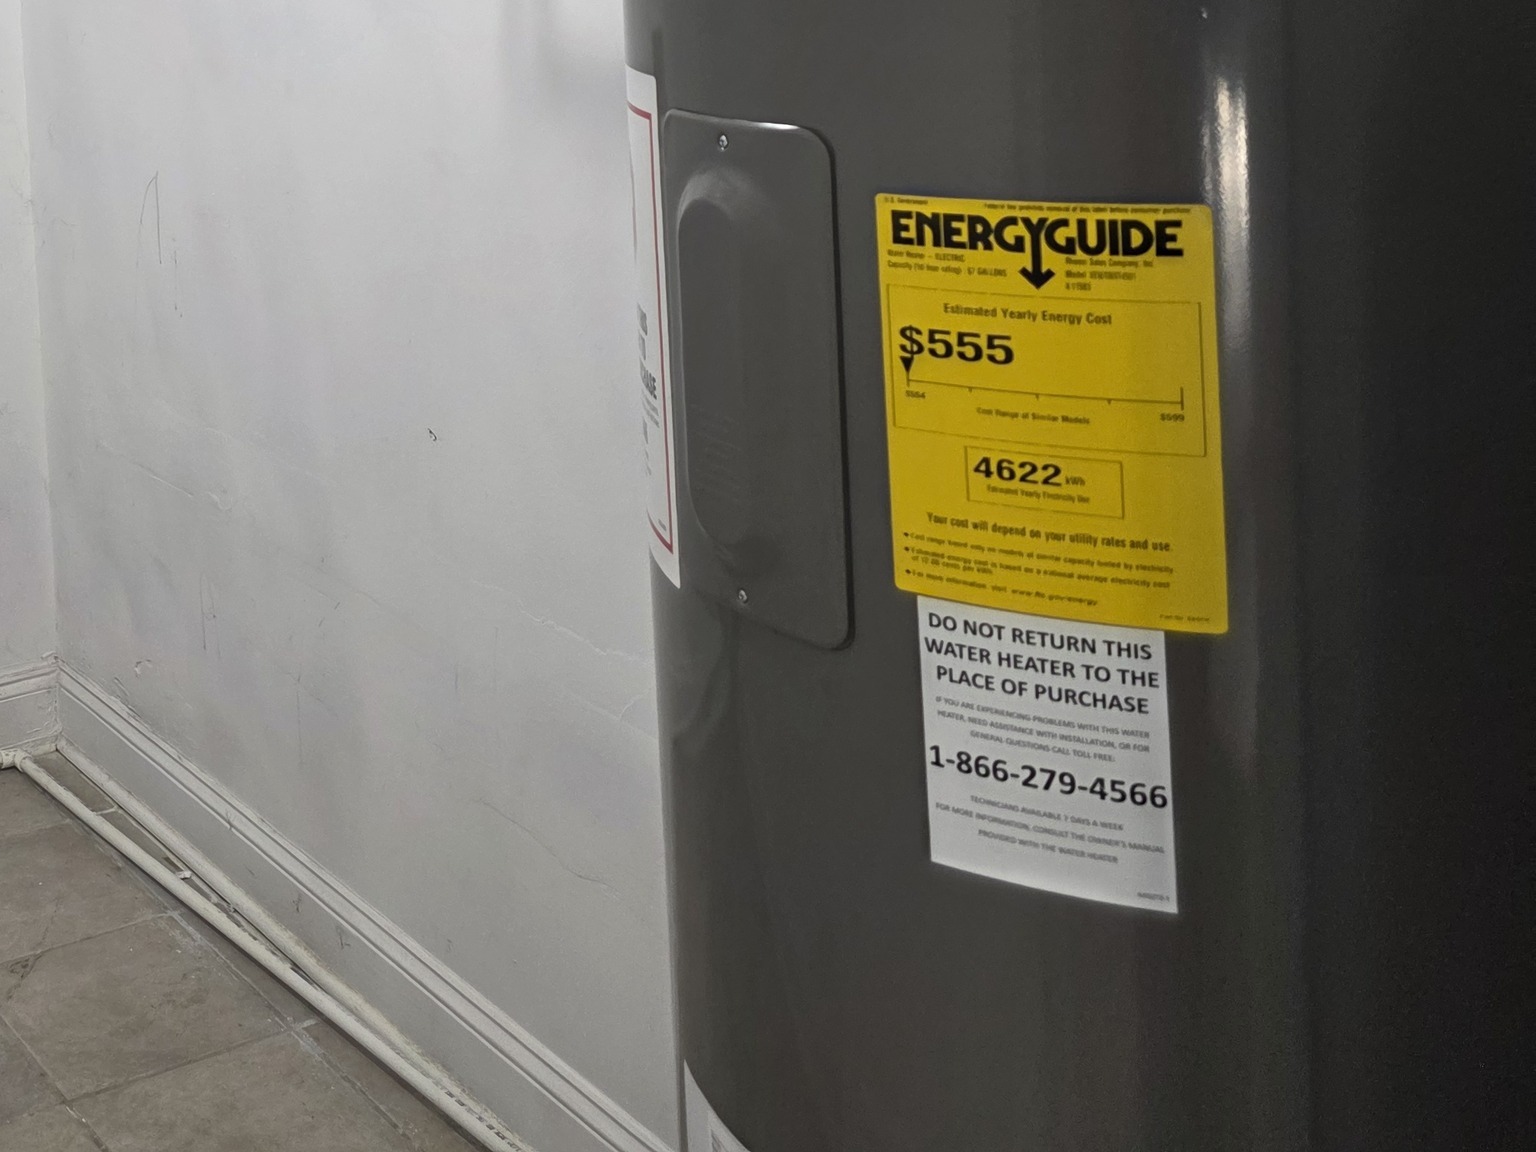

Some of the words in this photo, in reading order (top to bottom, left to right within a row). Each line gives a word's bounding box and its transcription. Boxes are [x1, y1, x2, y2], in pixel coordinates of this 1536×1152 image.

[891, 209, 1184, 258] ENERGYGUIDE
[943, 302, 997, 318] Estimated
[1001, 308, 1037, 322] Yearly
[1041, 310, 1082, 325] Energy
[1086, 312, 1112, 324] Cost
[899, 325, 1014, 365] $555
[1062, 415, 1090, 425] Models
[973, 456, 1063, 487] 4622
[926, 512, 947, 523] Your
[950, 517, 968, 529] cost
[972, 520, 989, 532] will
[991, 522, 1026, 537] depend
[1030, 528, 1041, 538] on
[1045, 530, 1066, 544] your
[1069, 532, 1098, 548] utility
[1101, 536, 1126, 548] rates
[1129, 538, 1149, 551] and
[928, 612, 957, 632] DO
[963, 619, 1005, 641] NOT
[1012, 627, 1097, 655] RETURN
[1103, 639, 1153, 661] THIS
[924, 636, 992, 665] WATER
[998, 651, 1076, 679] HEATER
[1081, 663, 1111, 683] TO
[1117, 668, 1160, 689] THE
[937, 665, 995, 691] PLACE
[1001, 678, 1029, 697] OF
[1034, 684, 1150, 715] PURCHASE
[960, 701, 975, 711] ARE
[1032, 715, 1076, 730] PROBLEMS
[1077, 721, 1100, 733] WITH
[1101, 725, 1120, 735] THIS
[1121, 729, 1150, 740] WATER
[968, 716, 988, 727] NEED
[989, 720, 1034, 737] ASSISTANCE
[1036, 729, 1058, 741] WITH
[1119, 740, 1131, 751] OR
[1133, 742, 1150, 753] FOR
[970, 729, 1004, 744] GENERAL
[1005, 737, 1050, 753] QUESTIONS
[1051, 745, 1071, 756] CALL
[1072, 748, 1091, 759] TOLL
[929, 745, 1169, 809] 1-866-279-4566
[1020, 804, 1062, 821] AVAILABLE
[1070, 815, 1091, 827] DAYS
